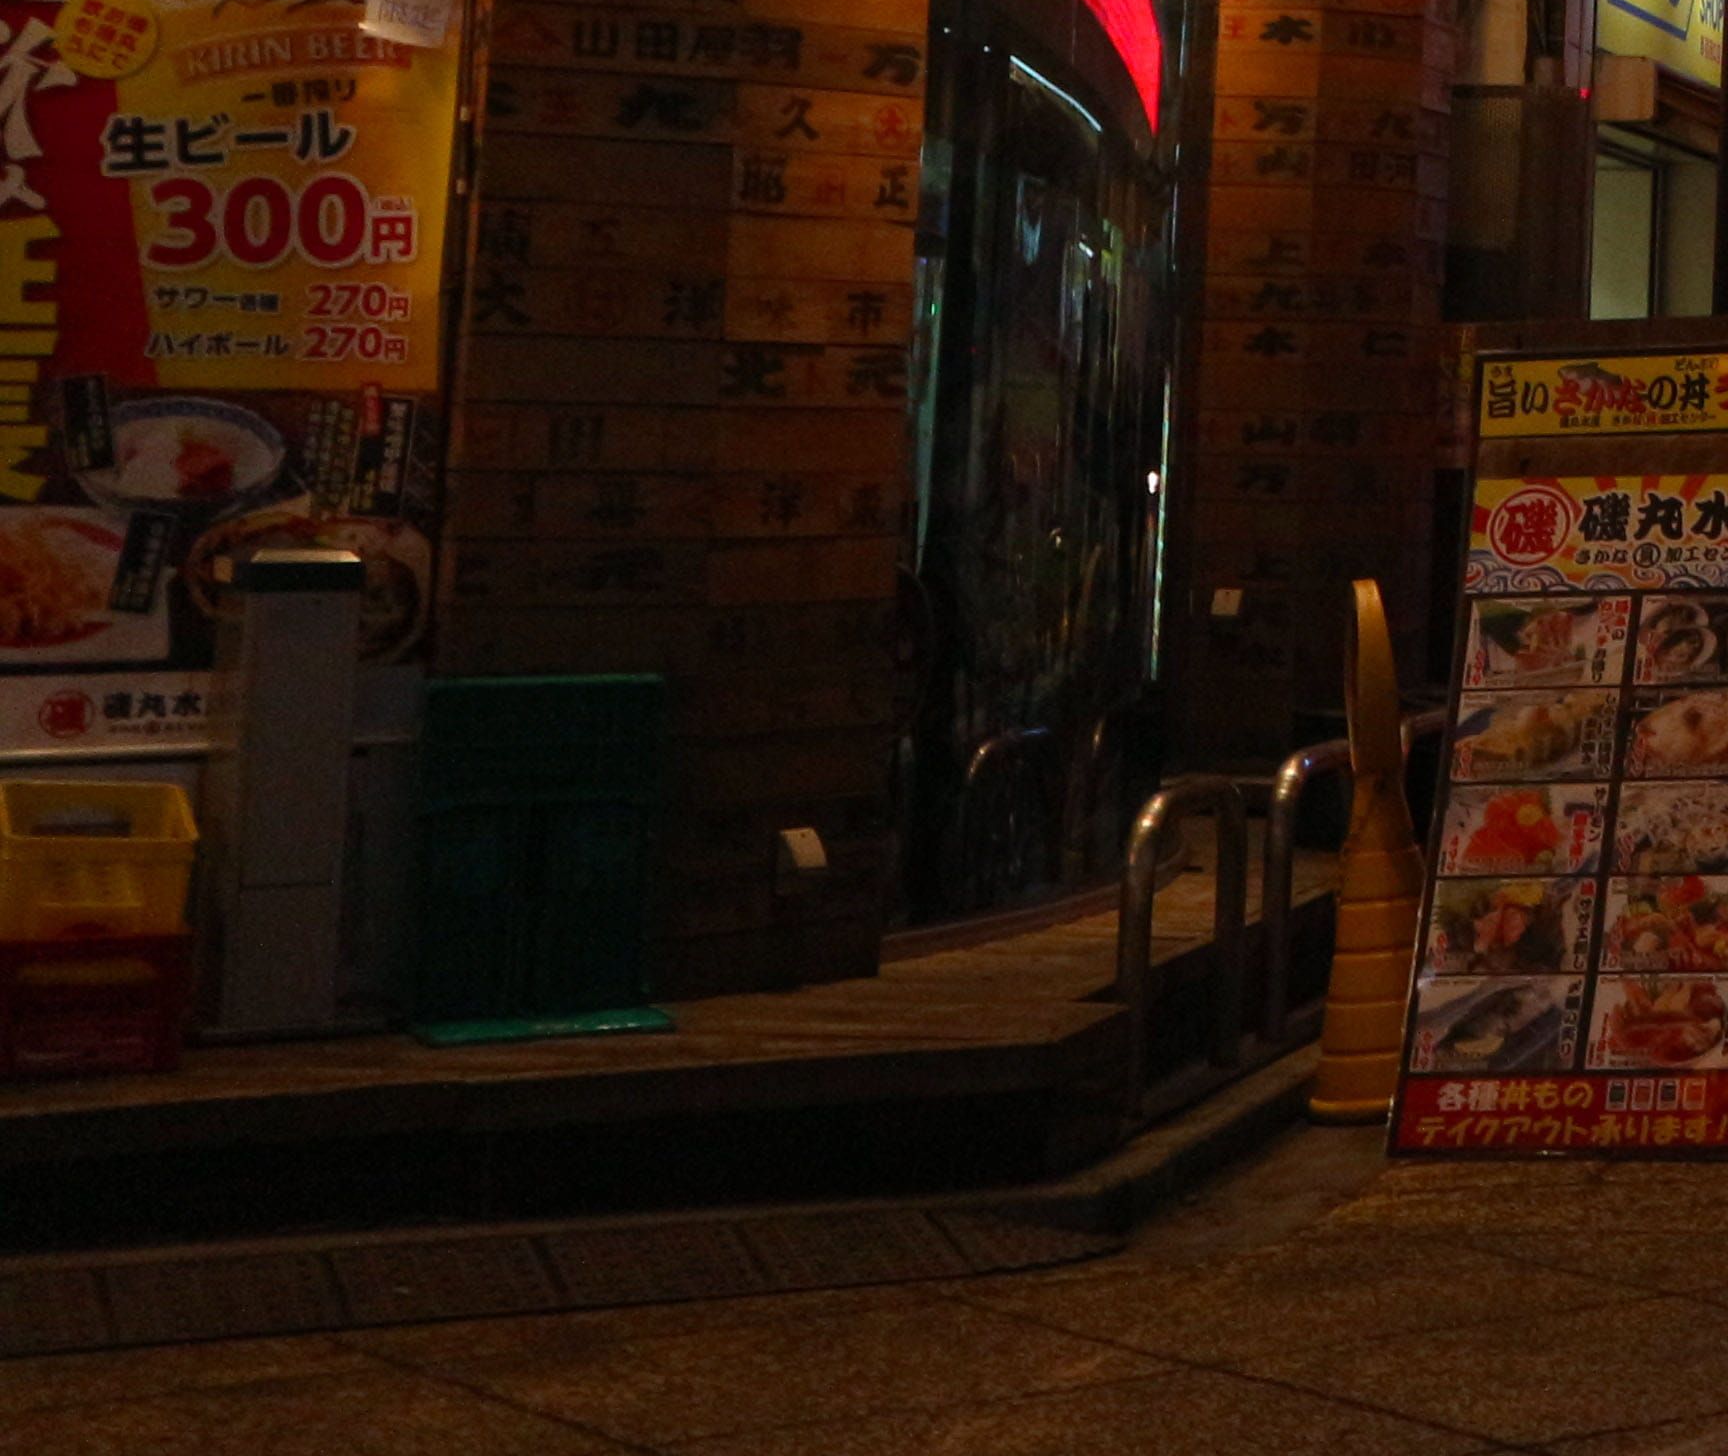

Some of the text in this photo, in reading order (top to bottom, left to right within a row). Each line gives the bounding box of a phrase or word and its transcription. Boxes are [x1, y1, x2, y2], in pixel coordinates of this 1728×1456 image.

[183, 37, 292, 79] KIRIN
[107, 110, 352, 174] 生ビール
[307, 283, 409, 318] 270円
[147, 326, 406, 360] ハイボール 270円
[1438, 1080, 1597, 1113] 各種丼もの
